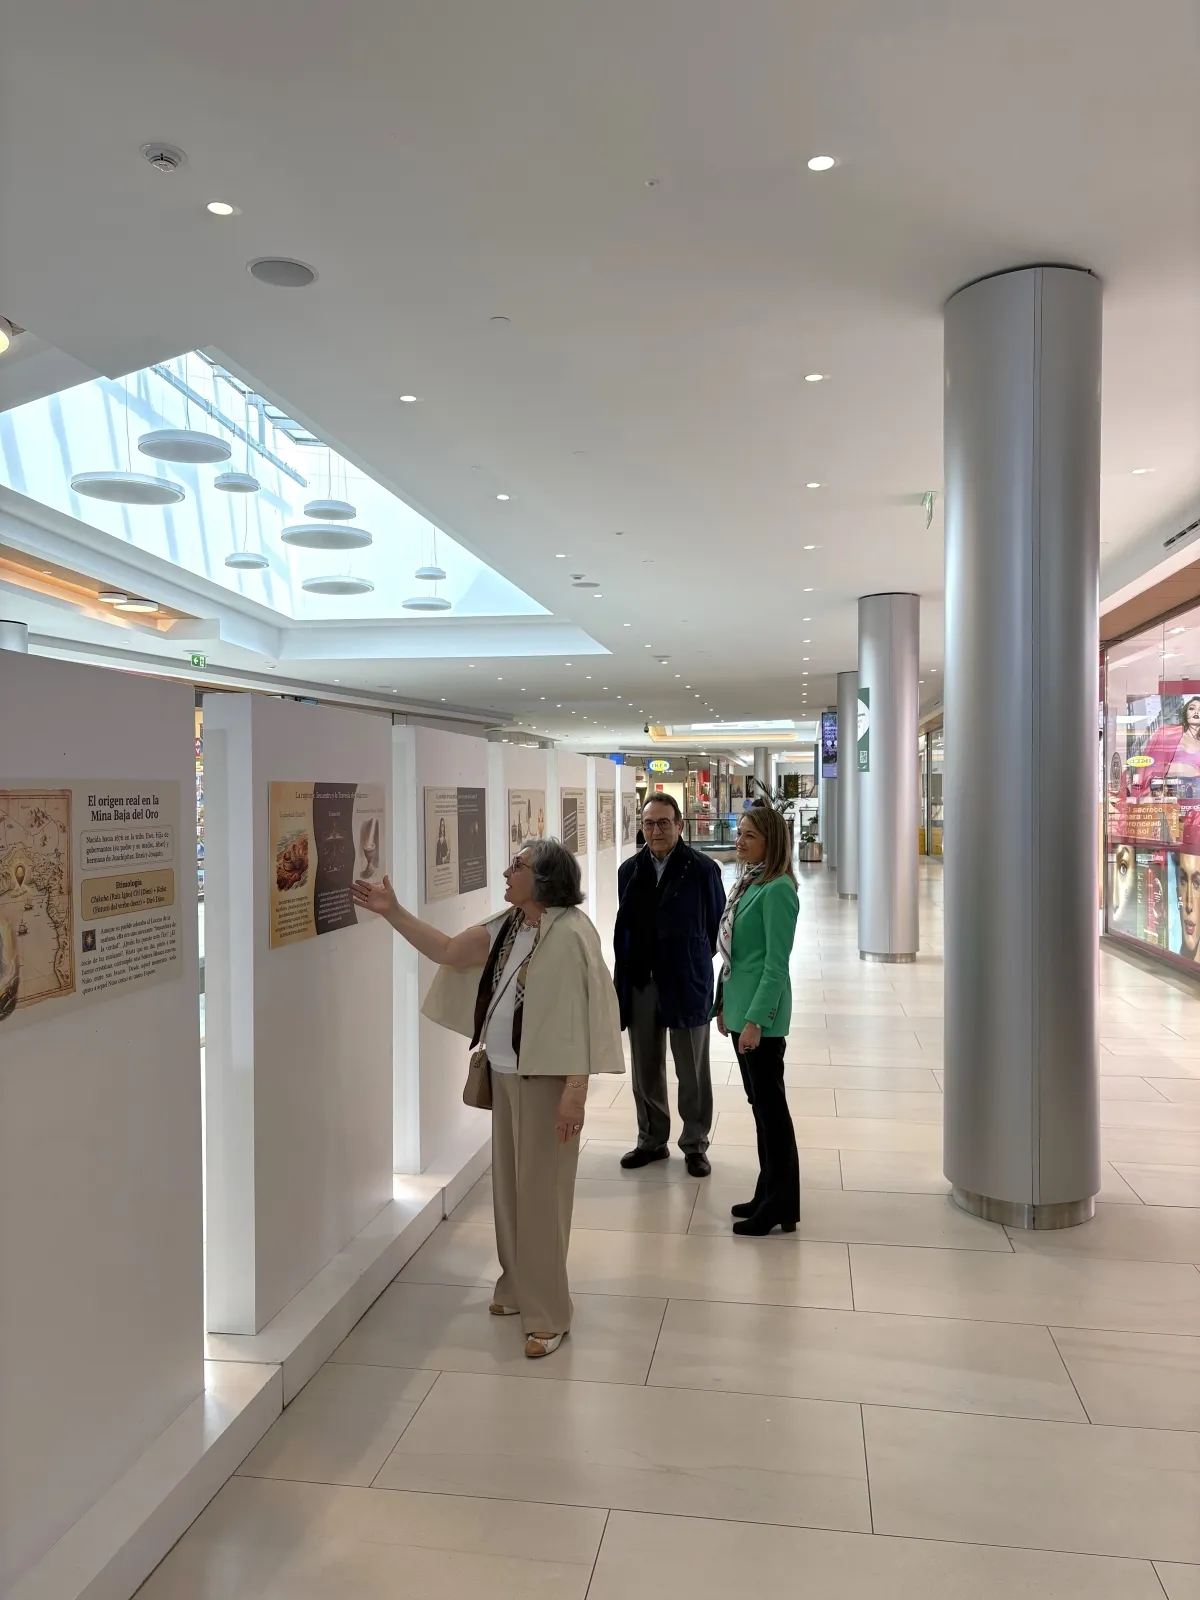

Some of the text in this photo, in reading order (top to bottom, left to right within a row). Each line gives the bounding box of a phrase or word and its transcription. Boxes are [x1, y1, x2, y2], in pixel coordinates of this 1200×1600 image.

[88, 795, 159, 808] El origen real en la
[91, 809, 158, 822] Mina Baja del Oro
